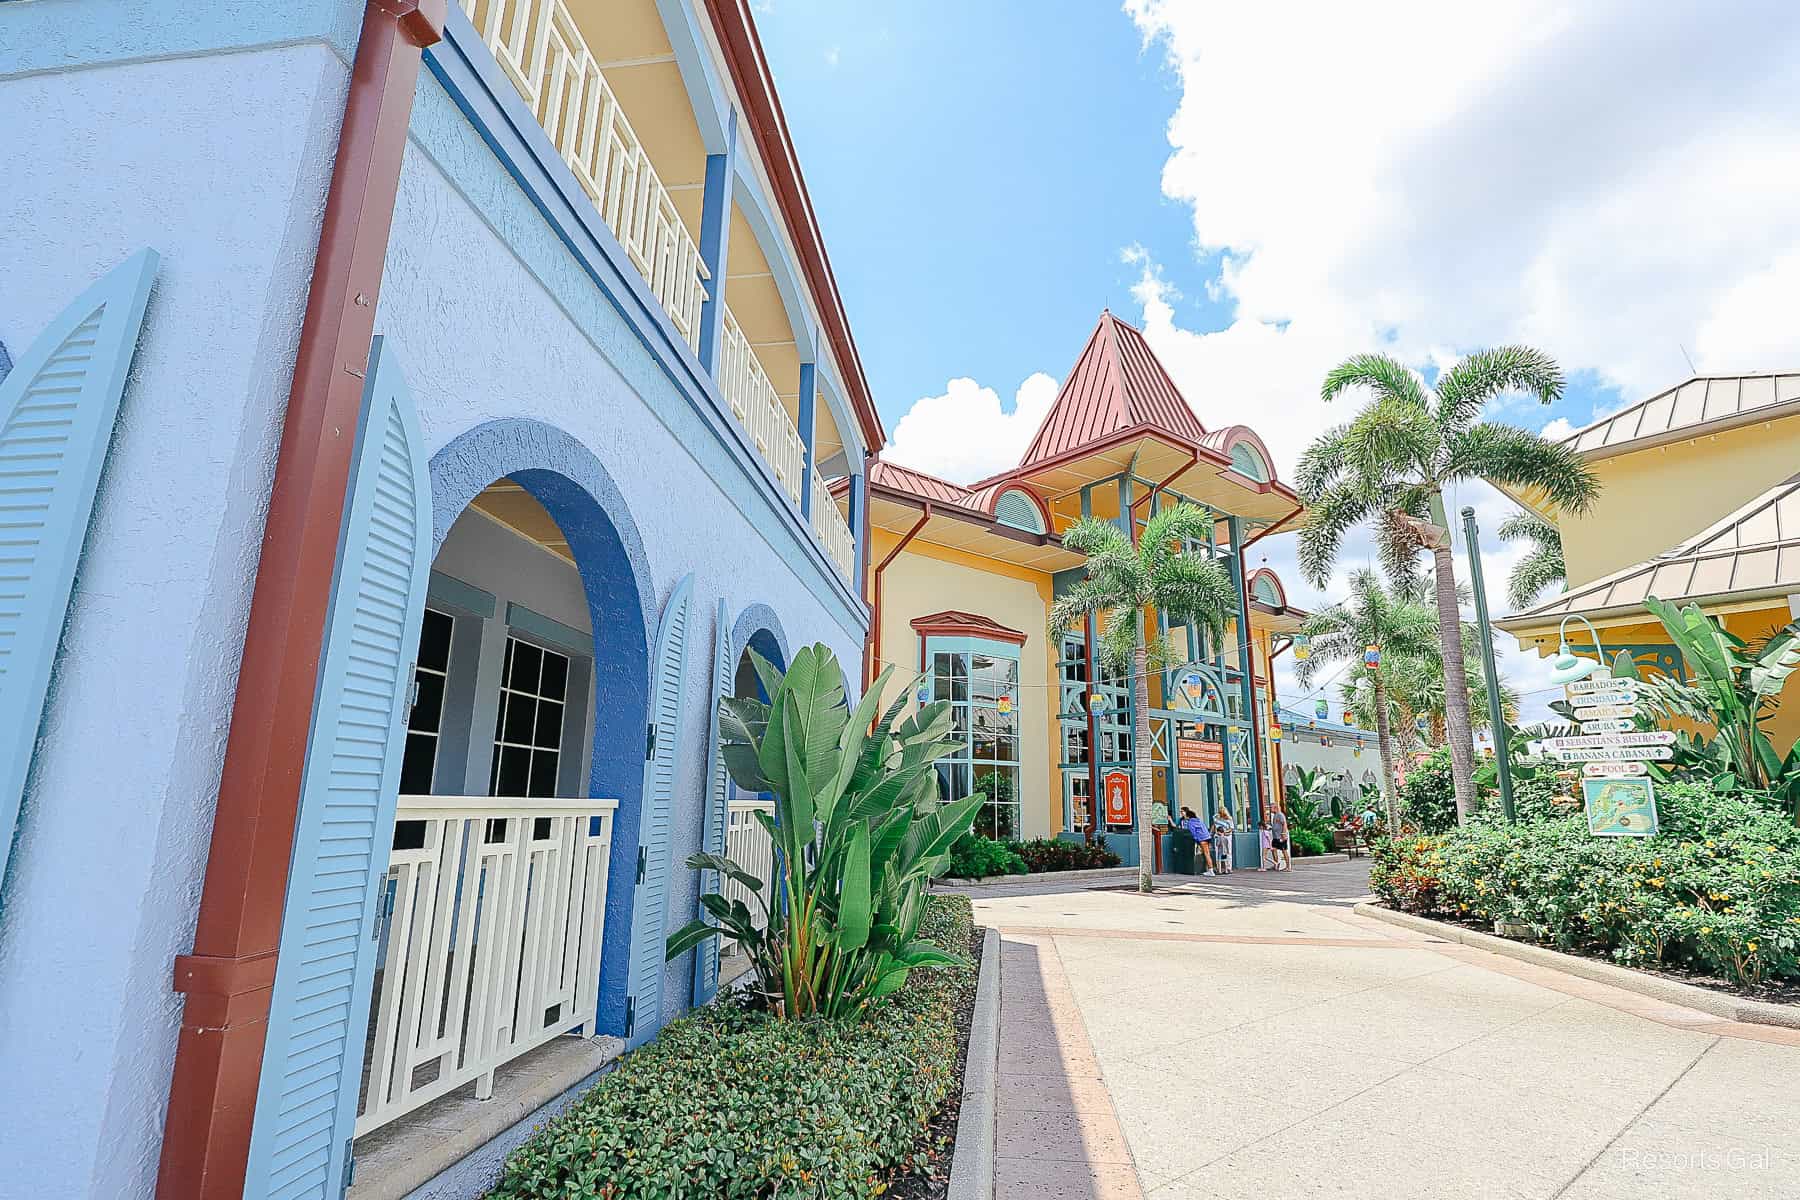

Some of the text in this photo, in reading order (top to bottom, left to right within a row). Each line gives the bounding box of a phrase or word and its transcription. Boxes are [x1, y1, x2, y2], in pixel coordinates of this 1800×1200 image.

[1573, 680, 1617, 691] BARBADOS
[1576, 695, 1618, 704] TRINIDAD
[1579, 708, 1617, 717] JAMAICA
[1586, 721, 1616, 730] ARUBA
[1566, 734, 1656, 746] SEBASTIAN'S BISTRO
[1573, 750, 1652, 760] BANANA CABANA
[1601, 765, 1627, 773] POOL
